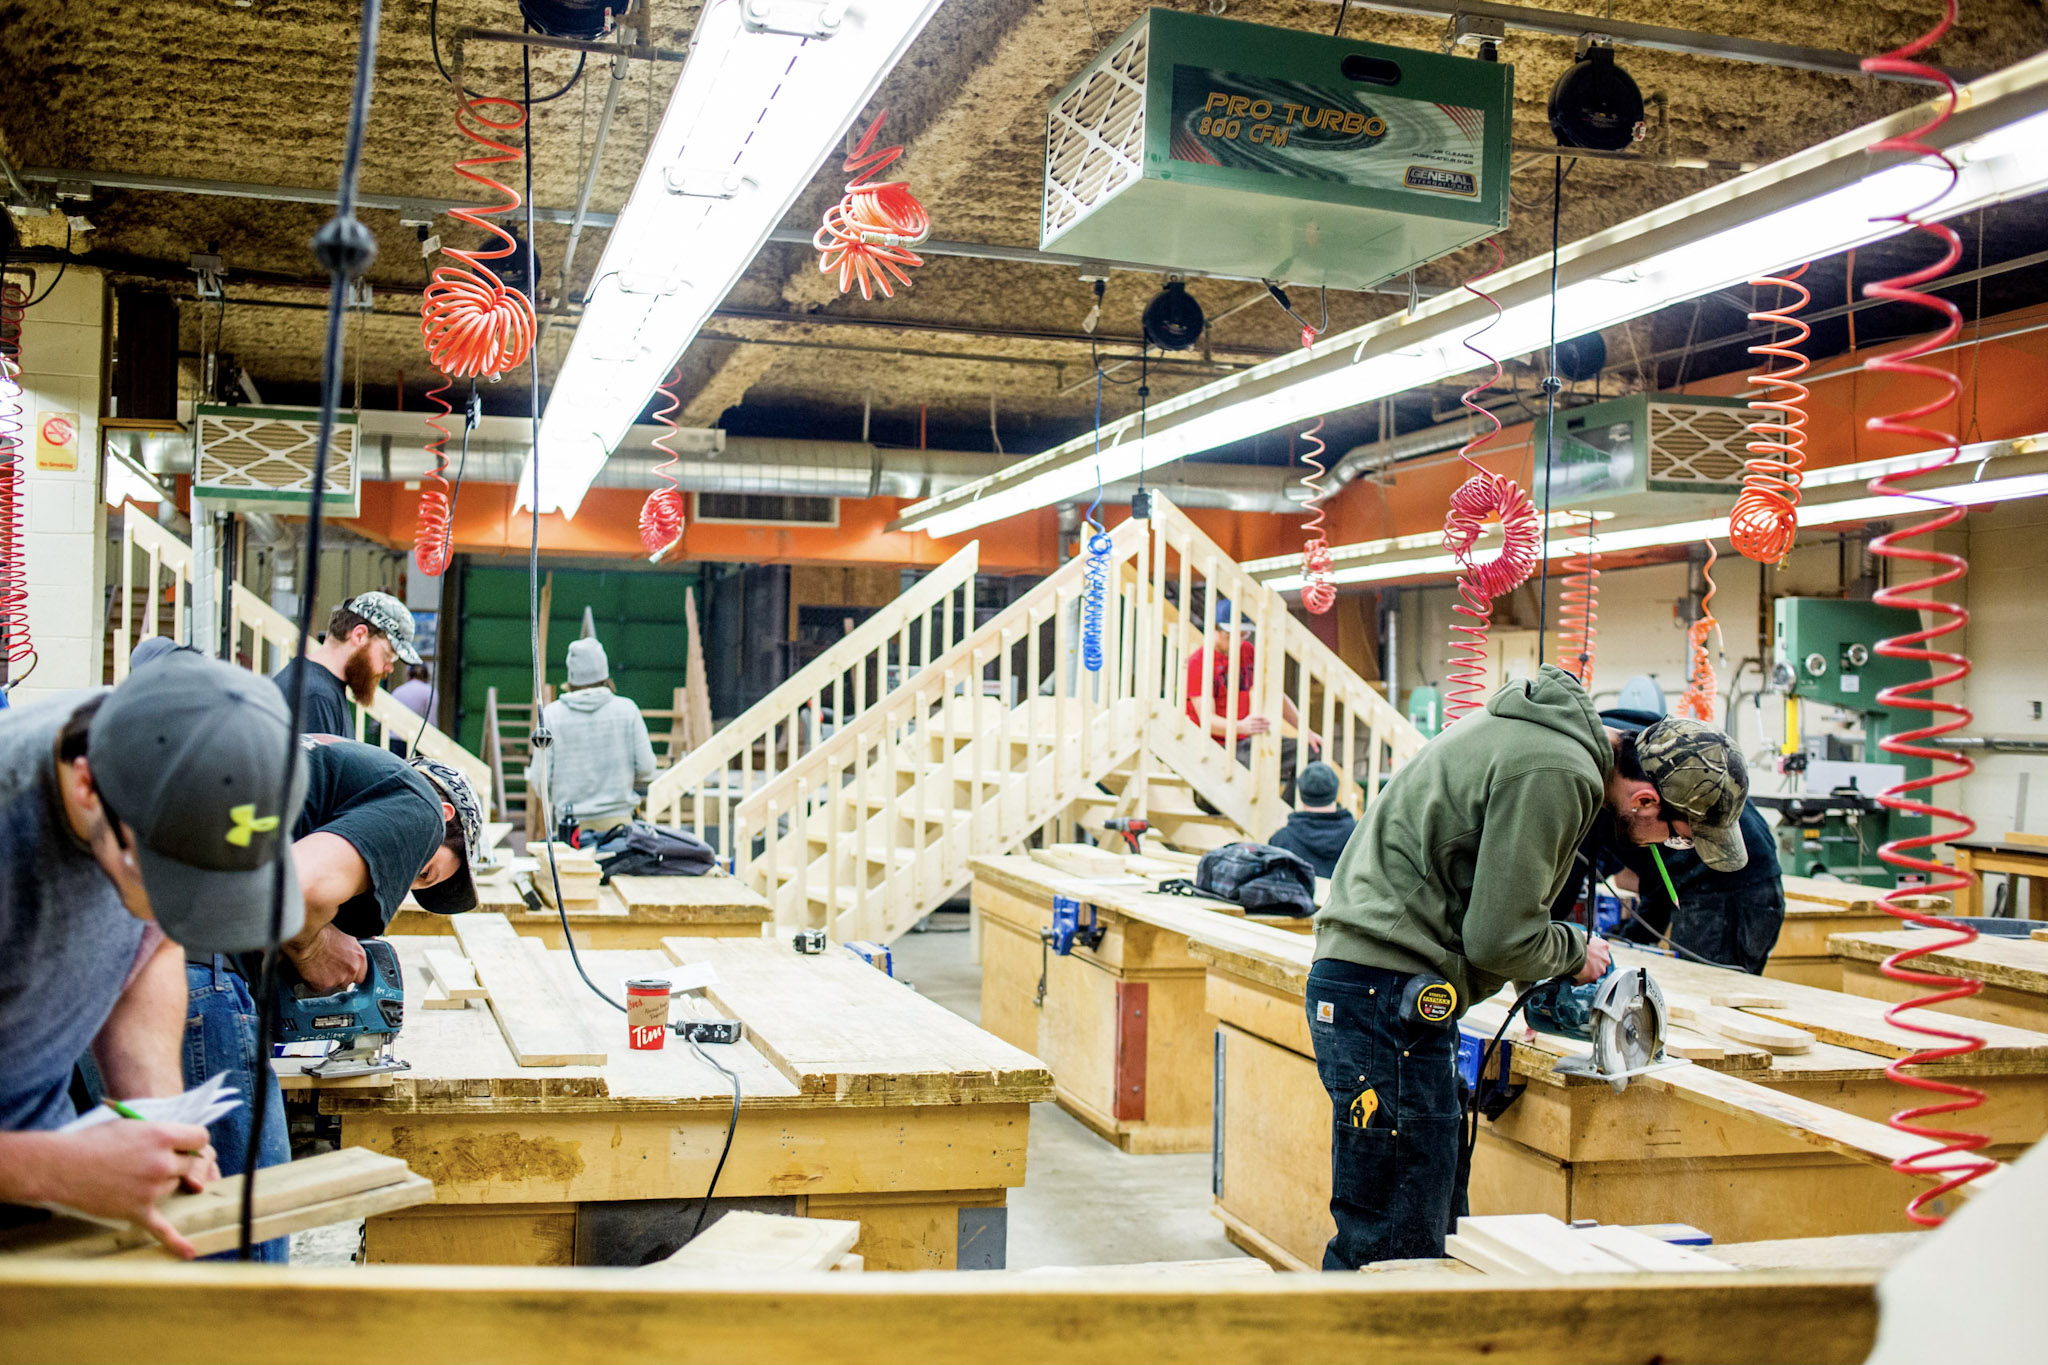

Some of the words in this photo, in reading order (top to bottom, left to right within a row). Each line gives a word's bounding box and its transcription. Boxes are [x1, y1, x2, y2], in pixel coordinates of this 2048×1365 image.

[1204, 92, 1273, 121] PRO
[1282, 103, 1387, 137] TURBO
[1199, 116, 1241, 140] 800
[1248, 123, 1290, 148] CFM
[1408, 177, 1473, 191] INTERNATIONAL
[1410, 168, 1472, 185] GENERAL
[1423, 996, 1450, 1005] FATMAX
